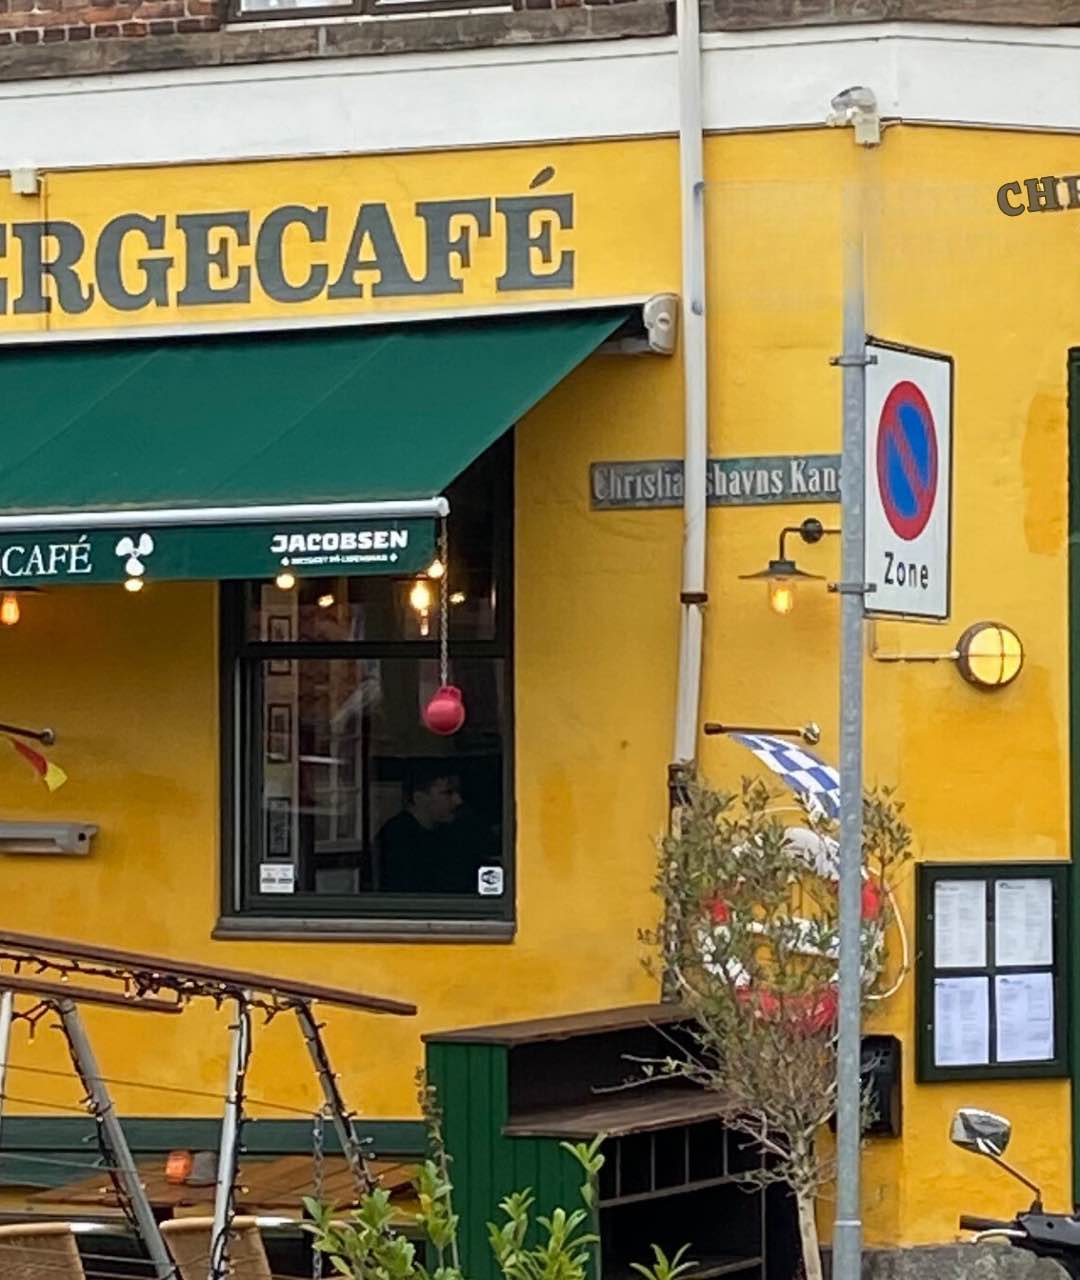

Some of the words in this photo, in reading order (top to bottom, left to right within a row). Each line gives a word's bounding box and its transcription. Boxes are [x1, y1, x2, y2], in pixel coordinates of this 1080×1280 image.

[0, 166, 575, 314] RGECAFÉ
[594, 463, 783, 500] Christiashavns
[789, 459, 842, 495] Kan
[0, 534, 92, 577] CAFÉ
[270, 530, 408, 553] JACOBSEN
[884, 551, 928, 590] Zone
